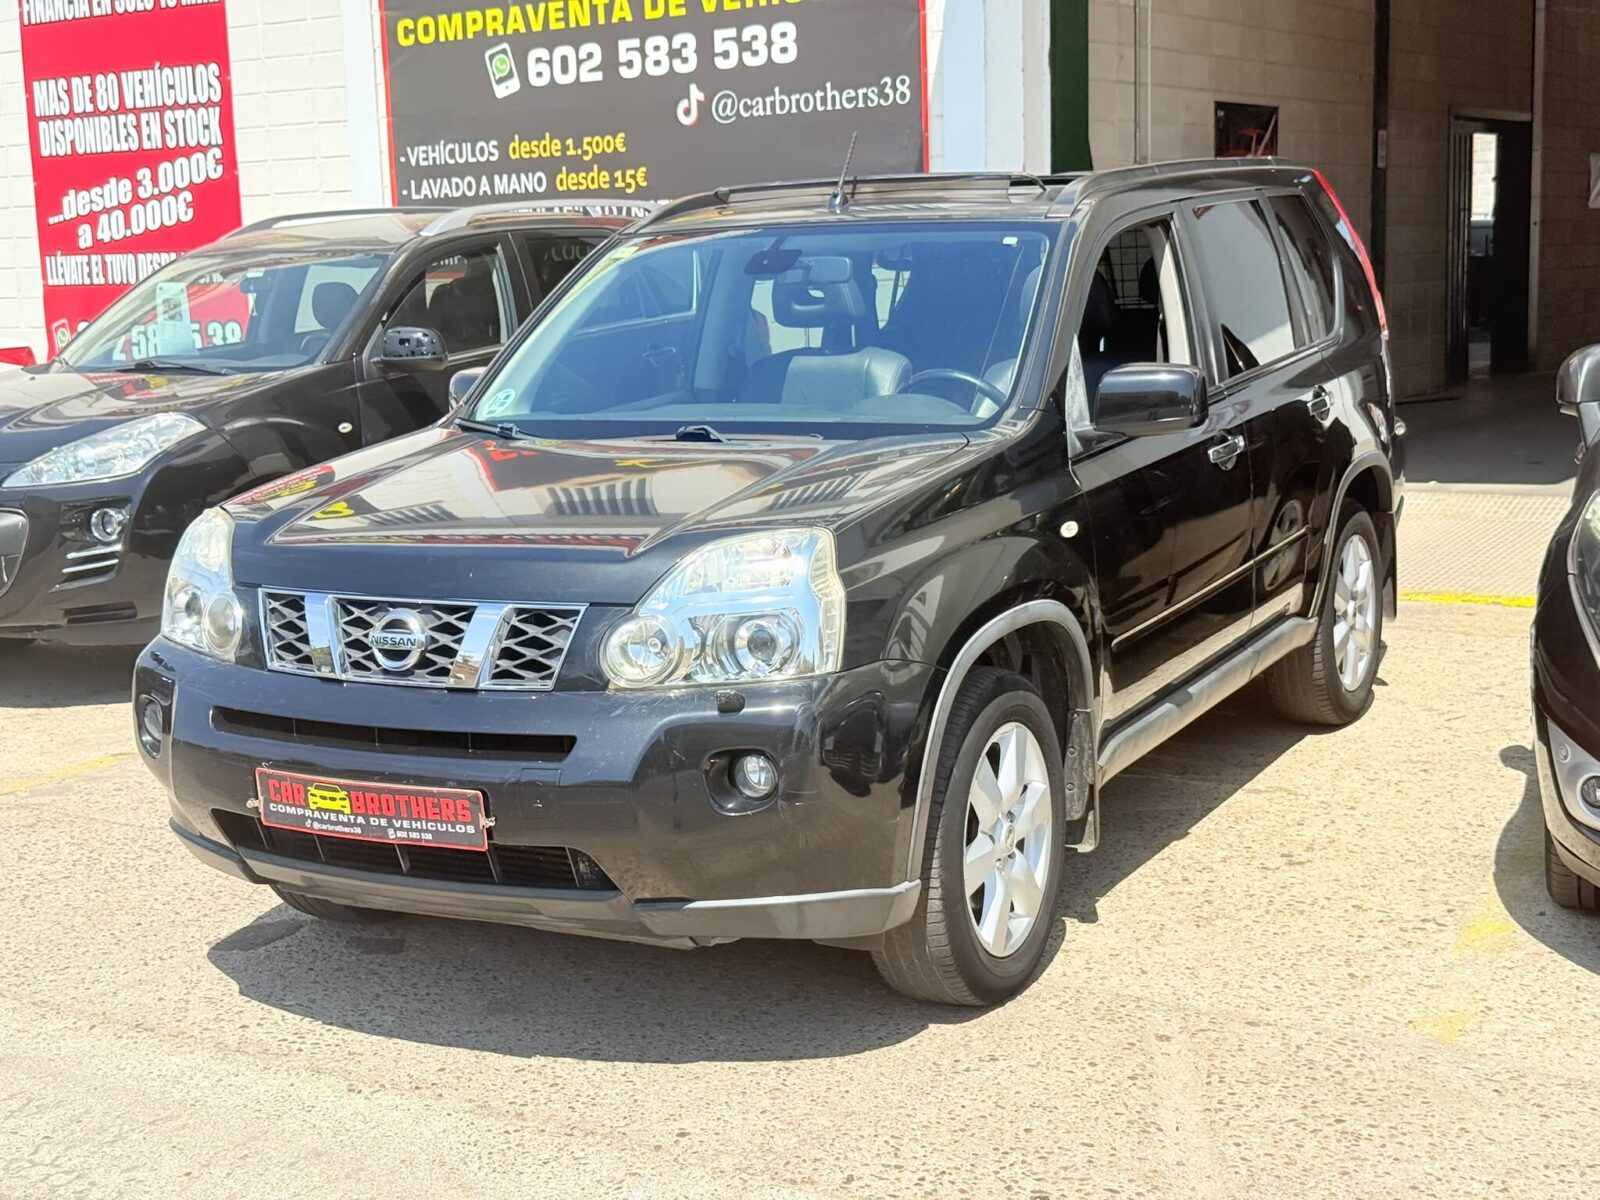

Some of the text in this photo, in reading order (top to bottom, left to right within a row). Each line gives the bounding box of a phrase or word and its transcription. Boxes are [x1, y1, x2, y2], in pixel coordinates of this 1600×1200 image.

[397, 0, 687, 47] COMPRAVENTA DE
[527, 21, 798, 87] 602 583 538
[33, 62, 222, 117] MAS DE 80 VEHÍCULOS
[711, 75, 911, 124] @carbrothers38
[38, 107, 223, 157] DISPONIBLES EN STOCK
[509, 133, 561, 160] desde
[565, 132, 626, 162] 1.500€
[48, 147, 224, 225] ...desde 3.000€
[479, 175, 492, 196] A
[494, 170, 547, 195] MANO
[556, 164, 609, 191] desde
[614, 167, 648, 194] 15€
[78, 190, 194, 249] a 40.000€
[45, 250, 91, 285] LLÉVATE
[90, 254, 105, 285] EL
[105, 253, 136, 285] TUYO
[370, 635, 416, 647] NISSAN
[268, 779, 472, 823] CAR BROTHERS
[269, 803, 476, 834] COMPRAVENTA DE VEHÍCULOS
